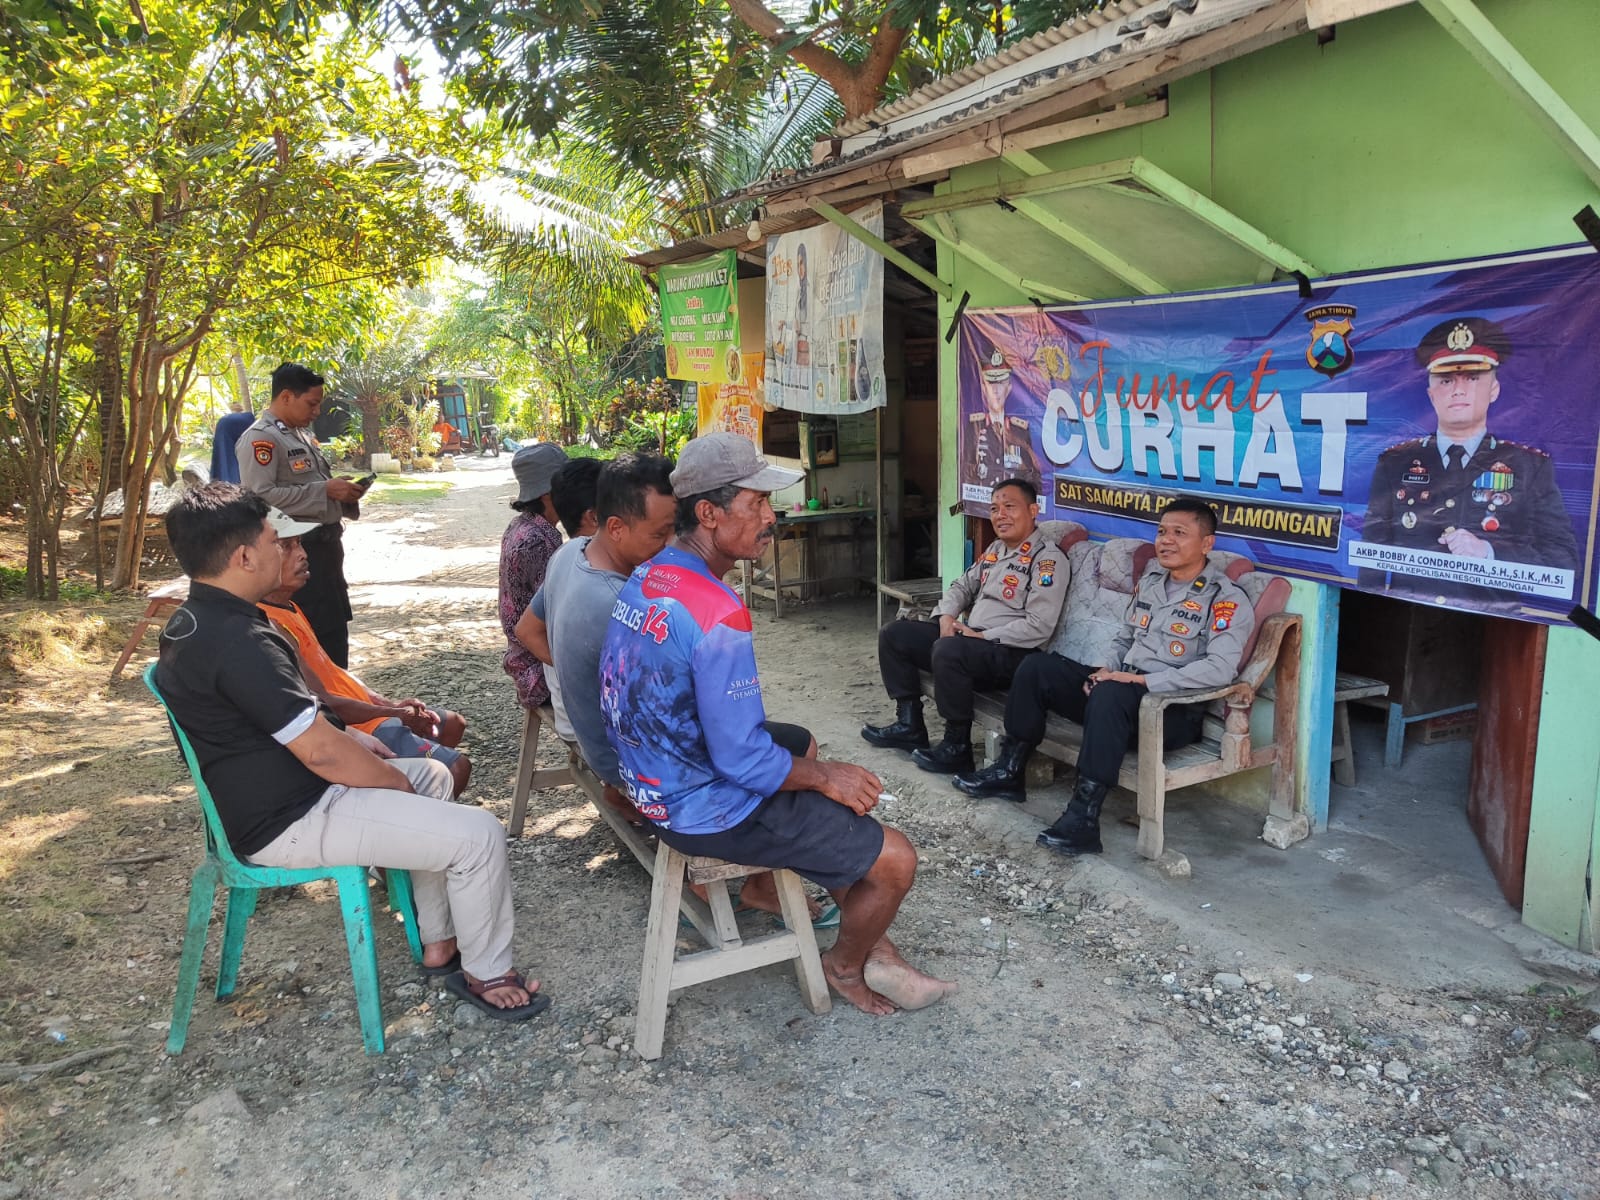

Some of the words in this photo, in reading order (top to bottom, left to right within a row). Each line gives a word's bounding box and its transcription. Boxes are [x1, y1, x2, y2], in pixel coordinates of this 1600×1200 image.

[1328, 307, 1353, 315] TIMUR
[1079, 339, 1280, 418] Jumat
[1041, 388, 1368, 494] CURHAT
[1059, 482, 1082, 500] SAT
[1084, 486, 1151, 513] SAMAPTA
[1222, 504, 1333, 538] LAMONGAN
[1356, 547, 1378, 558] AKBP
[1379, 550, 1407, 562] BOBBY
[1377, 562, 1404, 572] KEPALA
[1405, 566, 1451, 580] KEPOLISAN
[1452, 573, 1481, 584] RESOR
[1483, 577, 1535, 593] LAMONGAN
[612, 599, 644, 631] OBLOS
[641, 603, 670, 645] 14
[1171, 609, 1202, 623] POLRI
